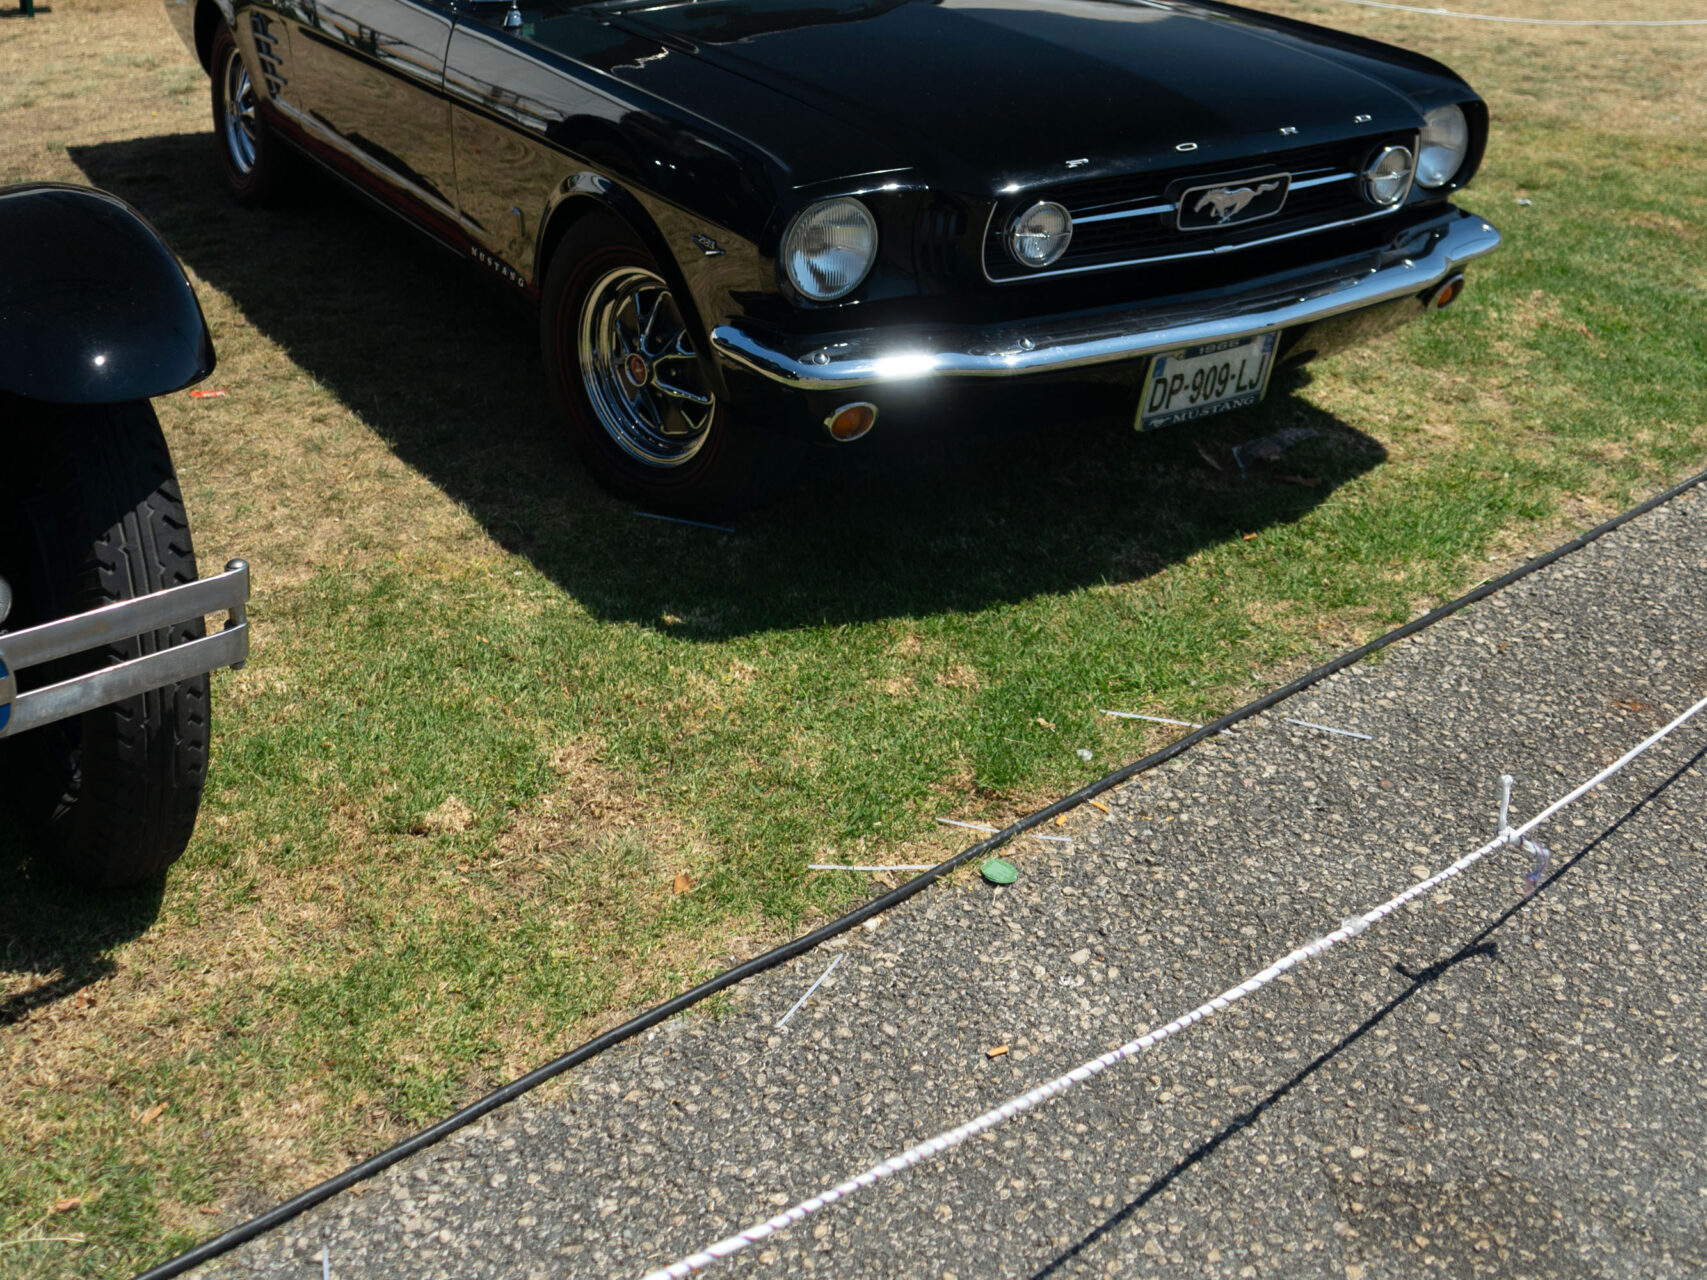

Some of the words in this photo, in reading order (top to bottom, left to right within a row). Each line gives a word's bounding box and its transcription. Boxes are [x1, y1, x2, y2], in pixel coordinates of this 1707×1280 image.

[471, 246, 525, 288] MUSTANG
[1147, 354, 1267, 413] DP-909-LJ
[1172, 395, 1255, 424] MUSTANG
